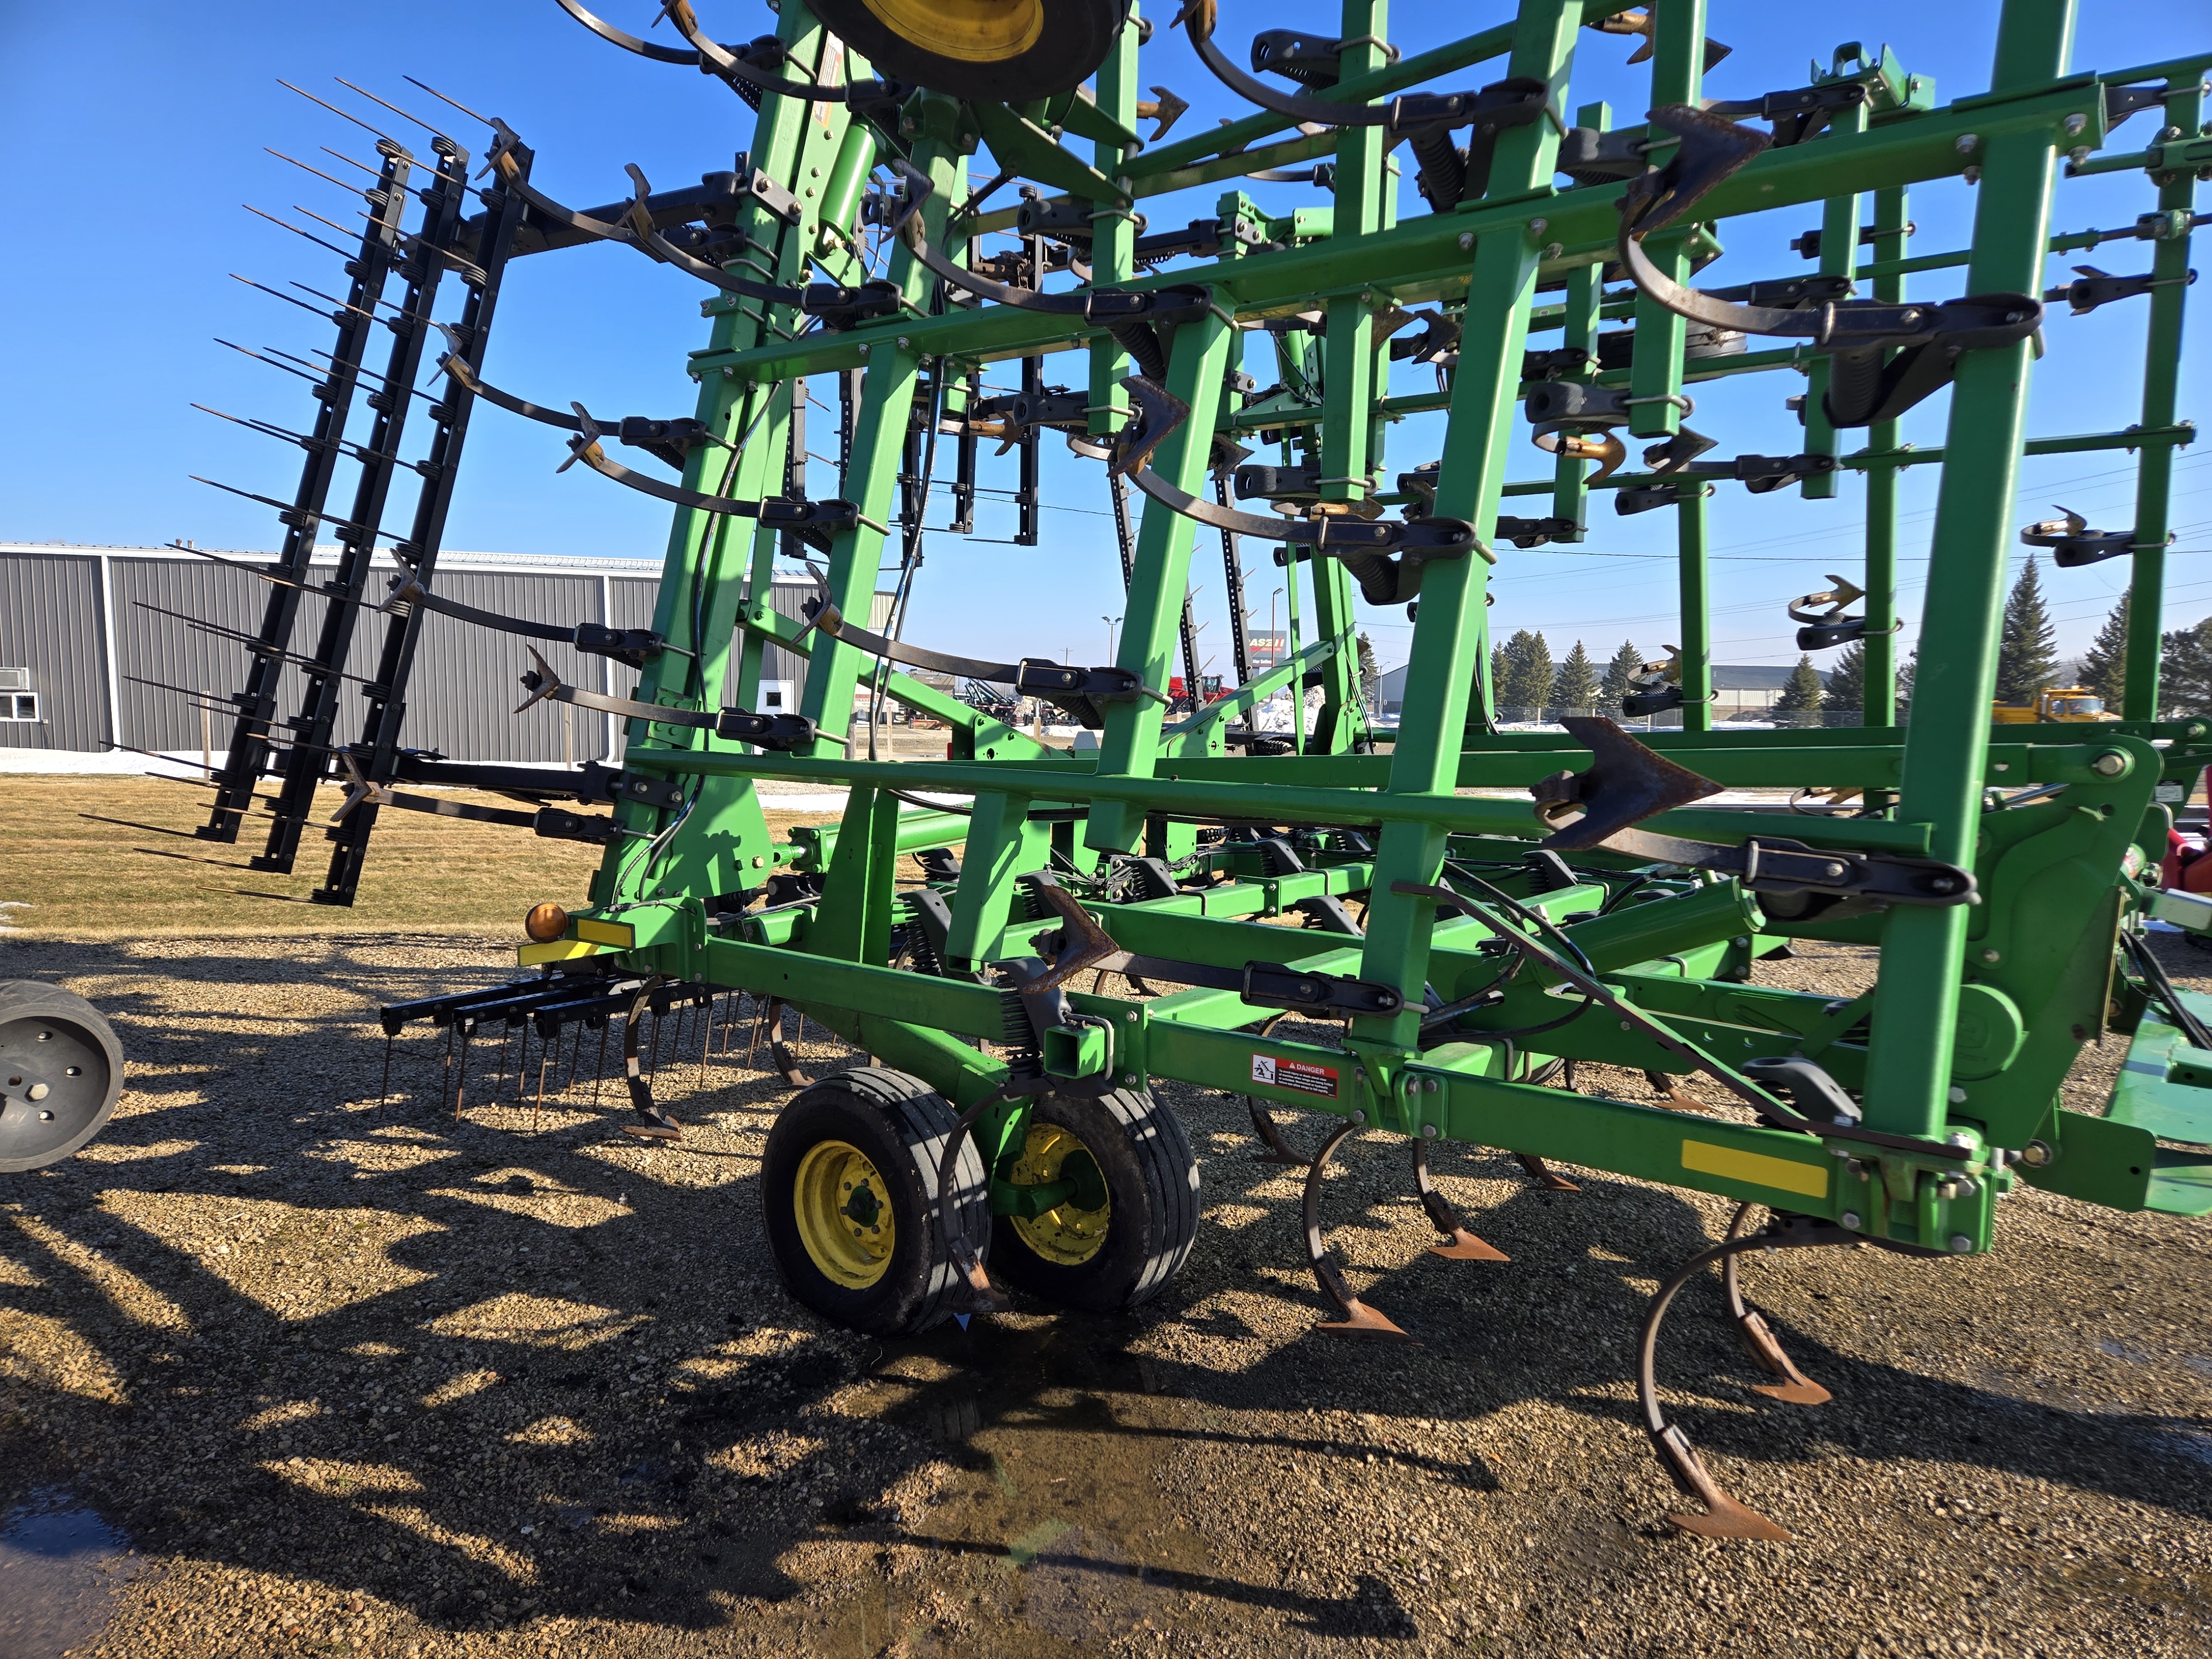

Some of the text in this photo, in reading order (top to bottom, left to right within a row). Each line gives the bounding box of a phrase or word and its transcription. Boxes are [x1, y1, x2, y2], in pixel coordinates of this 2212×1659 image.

[1234, 307, 1293, 321] EERE
[1249, 638, 1272, 646] ASE
[1296, 1063, 1324, 1075] DANGER
